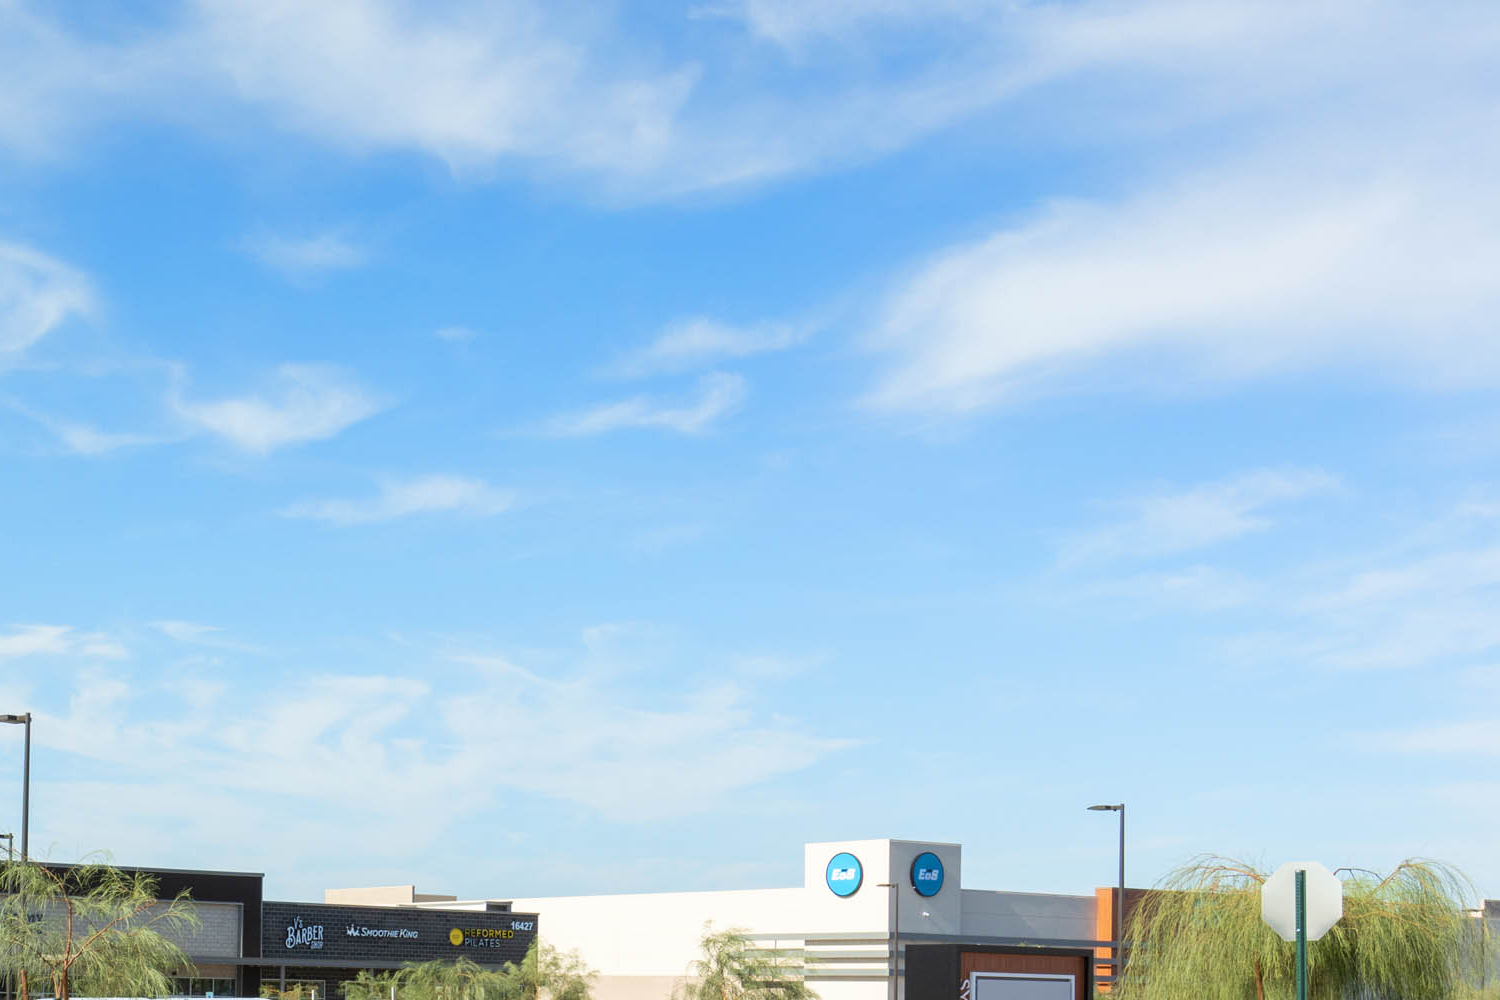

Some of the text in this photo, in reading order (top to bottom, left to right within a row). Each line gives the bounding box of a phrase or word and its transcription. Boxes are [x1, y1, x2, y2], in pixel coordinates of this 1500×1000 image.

[511, 921, 533, 931] 16427
[285, 925, 324, 949] BARBER
[464, 928, 514, 939] REFORMED
[464, 938, 501, 948] PILATES
